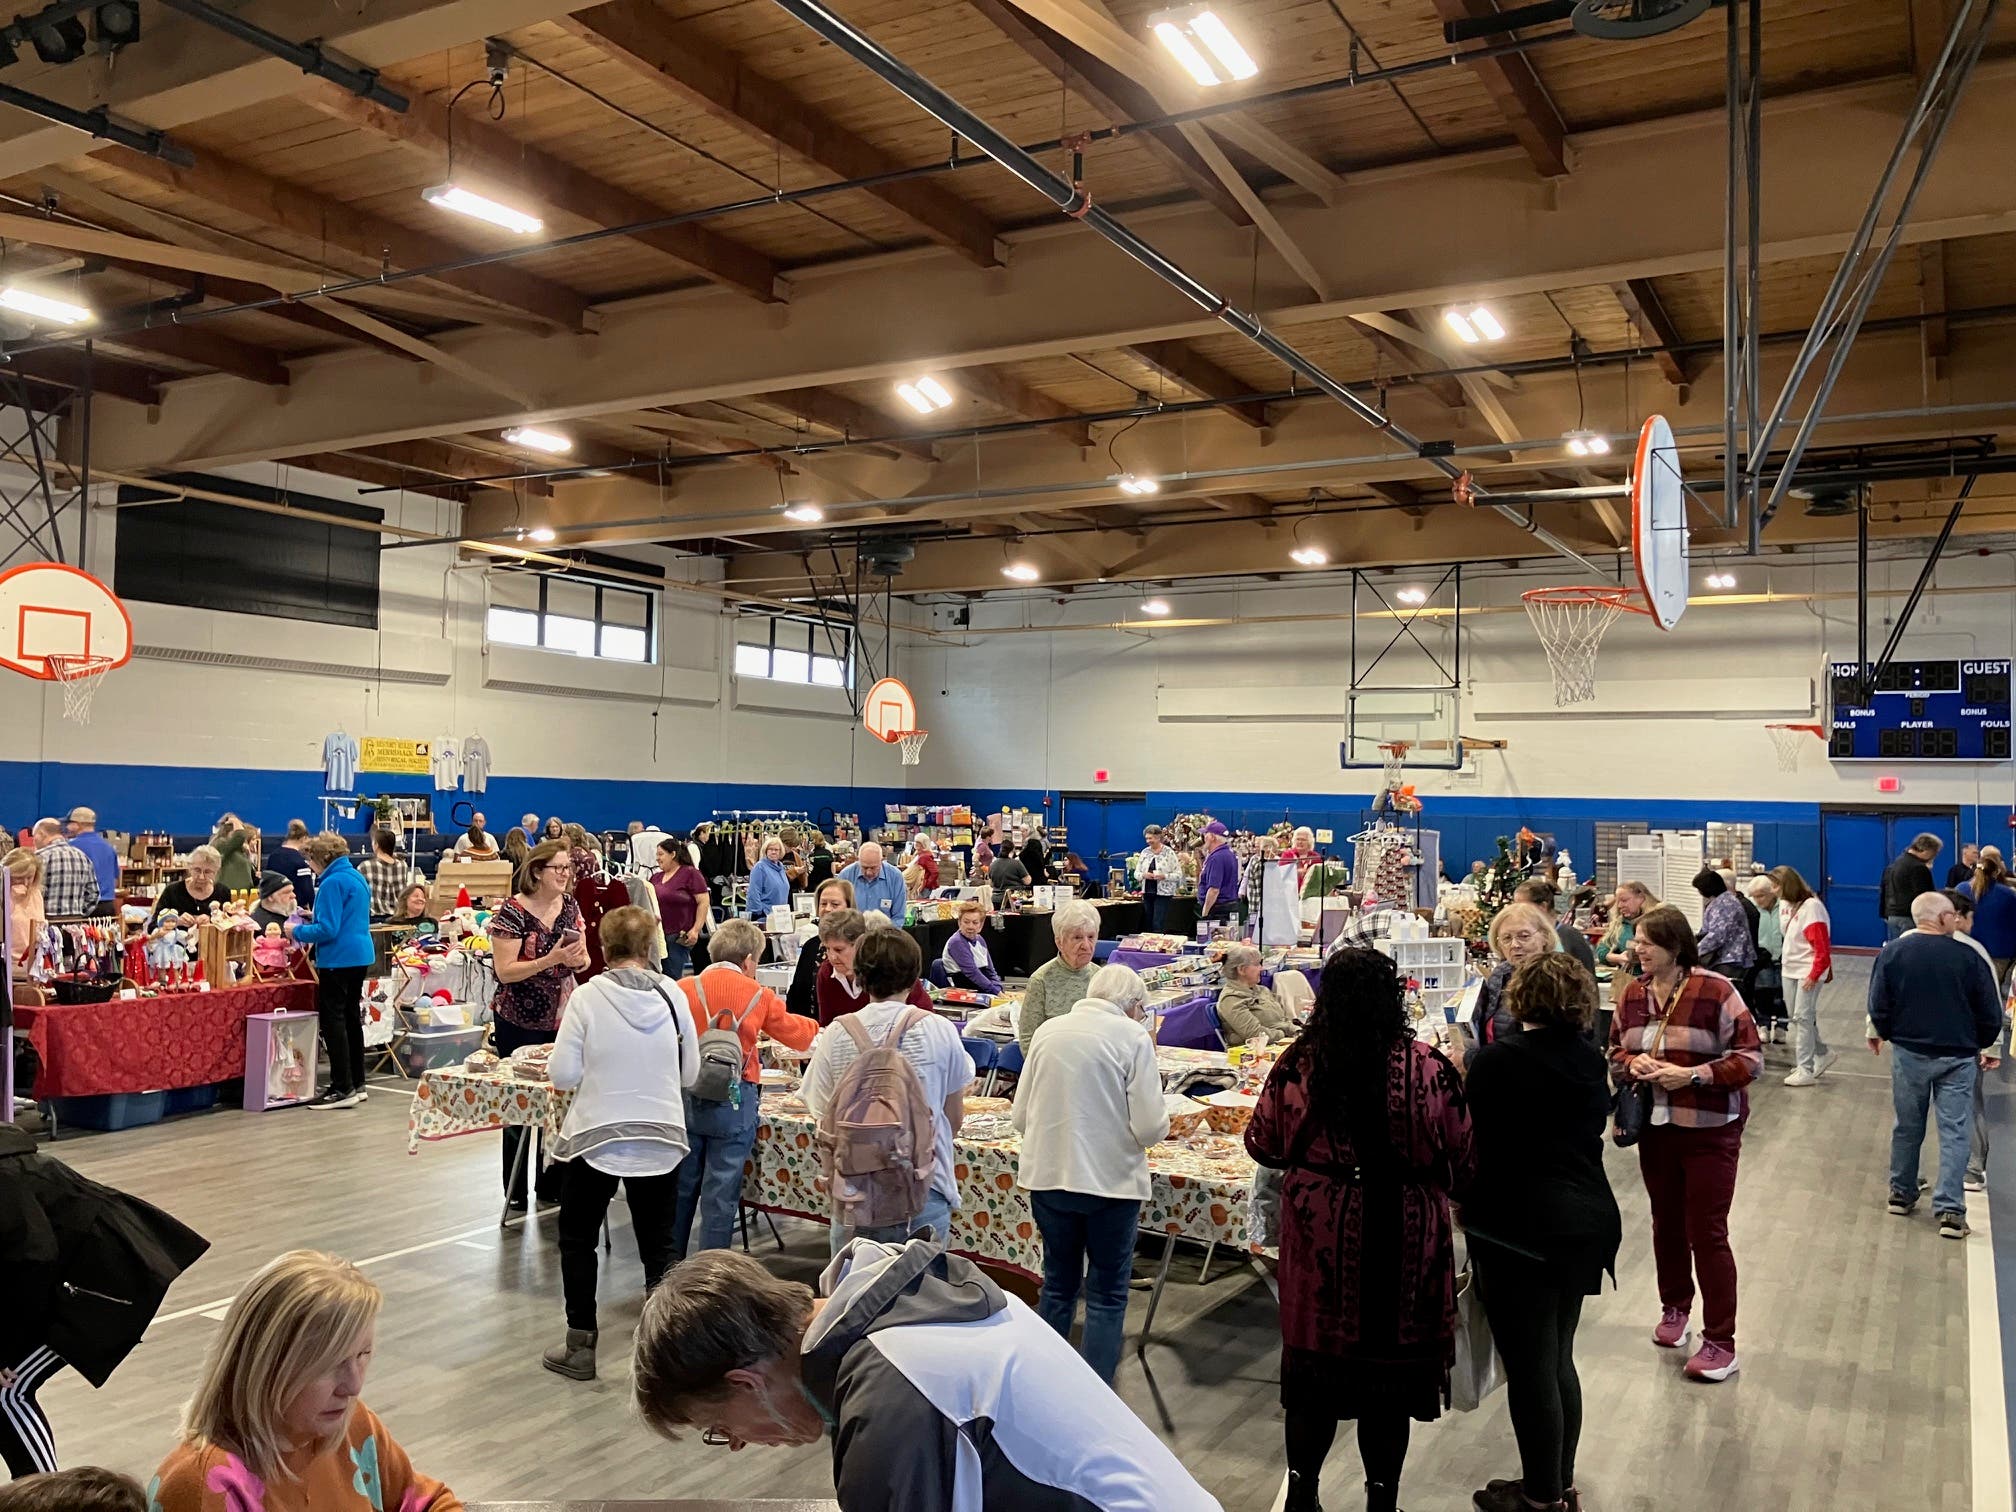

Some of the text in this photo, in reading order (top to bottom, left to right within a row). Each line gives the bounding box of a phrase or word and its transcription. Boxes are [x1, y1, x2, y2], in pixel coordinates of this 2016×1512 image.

[1963, 661, 2009, 675] GUEST
[1850, 709, 1875, 717] BONUS
[1960, 708, 1987, 716] BONUS
[1832, 721, 1856, 729] OULS
[1900, 721, 1934, 729] PLAYER
[1980, 720, 2010, 728] FOULS
